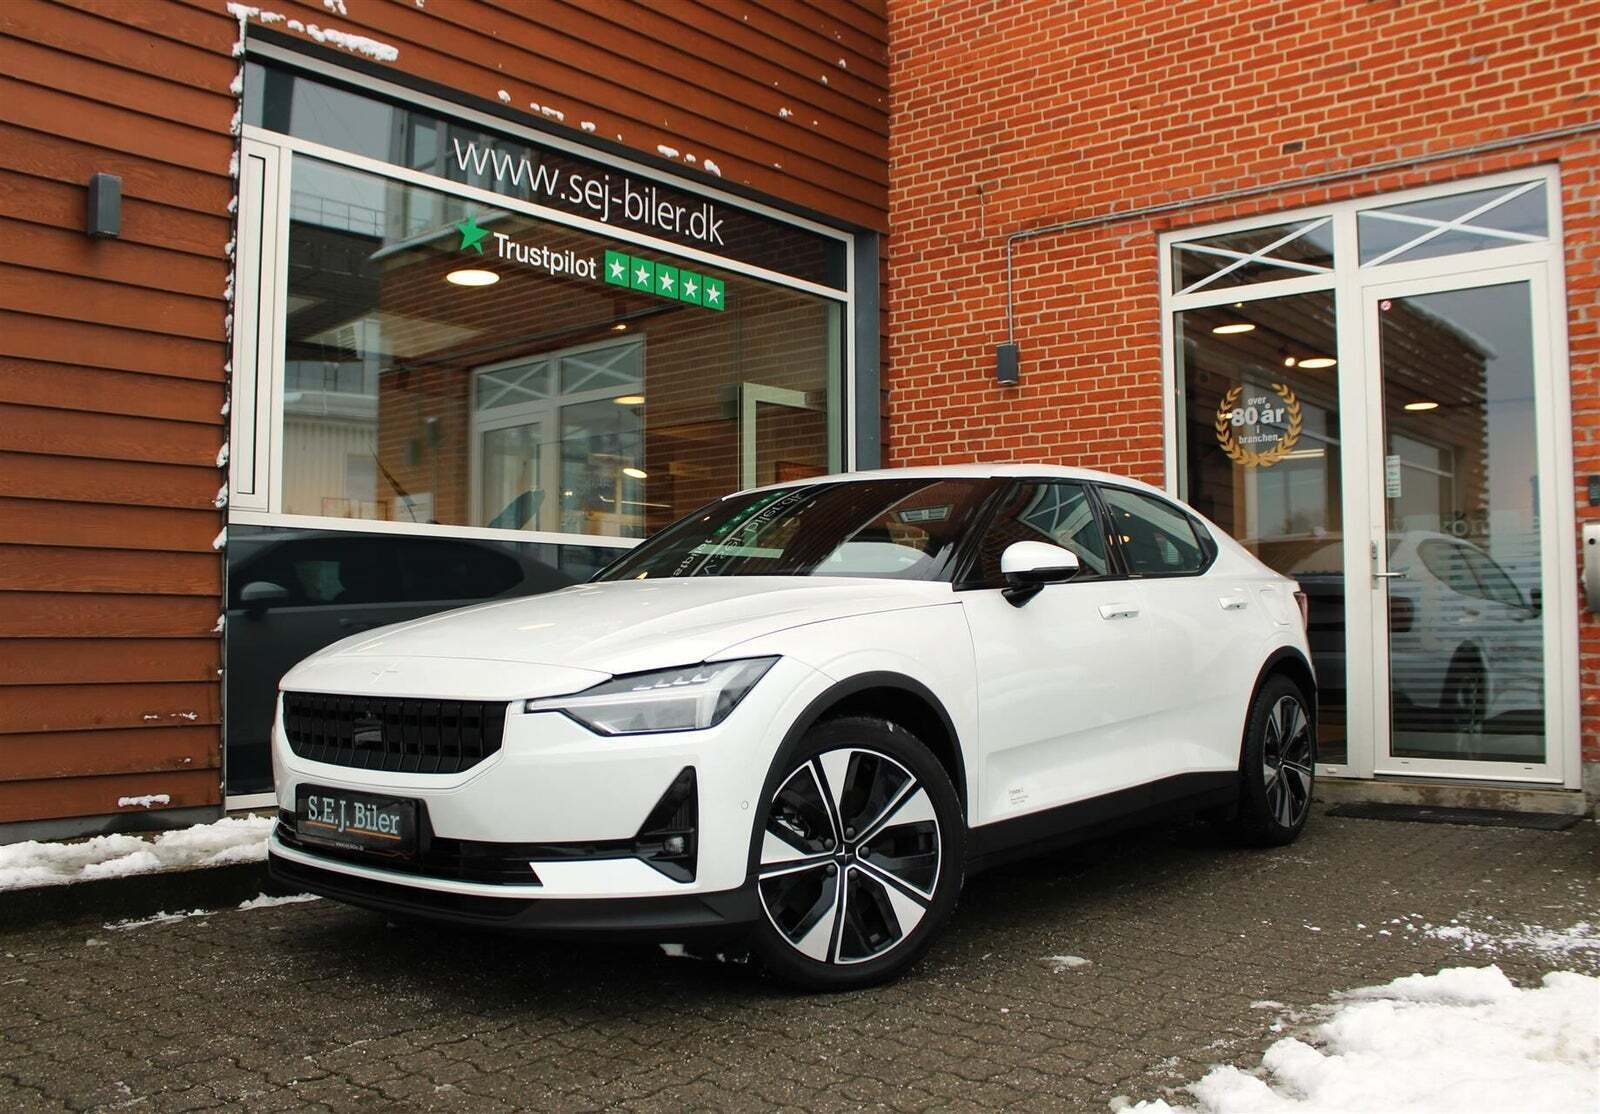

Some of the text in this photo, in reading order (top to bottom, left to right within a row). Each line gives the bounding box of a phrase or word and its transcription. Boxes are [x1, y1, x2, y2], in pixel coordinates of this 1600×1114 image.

[453, 137, 725, 246] www.sej-biler.dk
[493, 231, 597, 280] Trustpilot
[1231, 403, 1284, 426] 80 år
[1247, 396, 1266, 406] over
[1239, 434, 1278, 443] branchen
[308, 795, 400, 835] S.E.J. Biler
